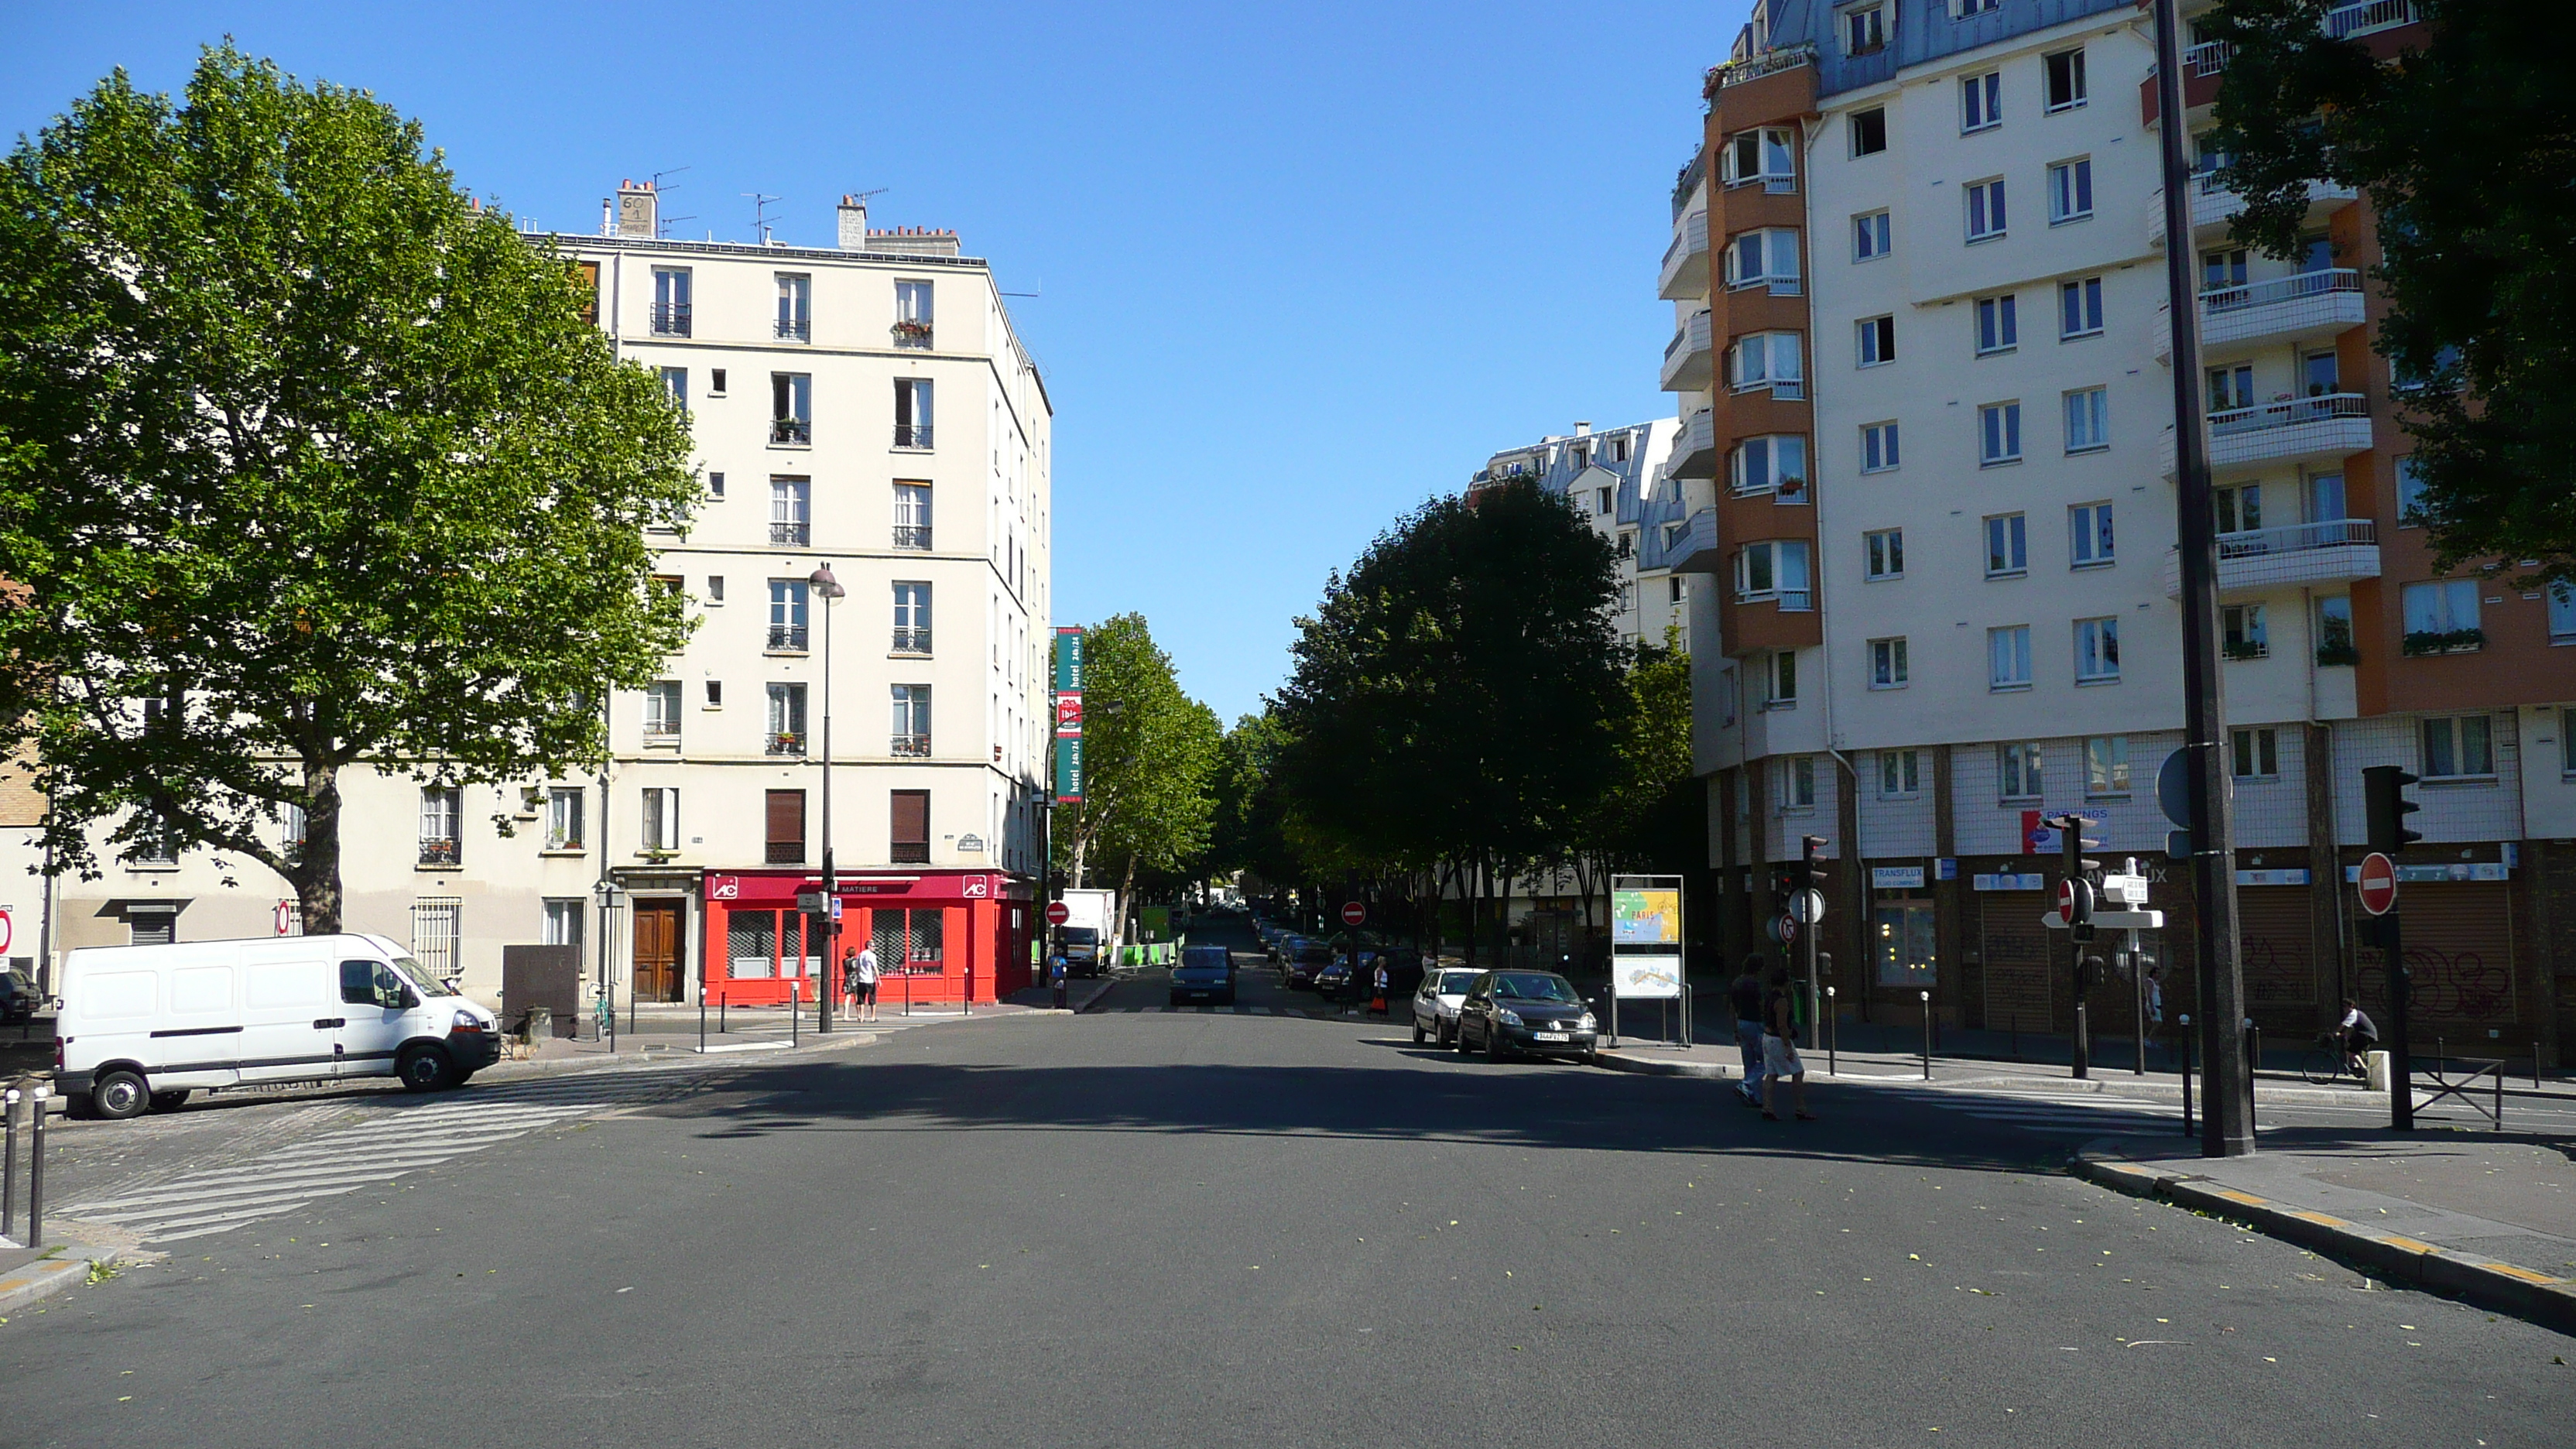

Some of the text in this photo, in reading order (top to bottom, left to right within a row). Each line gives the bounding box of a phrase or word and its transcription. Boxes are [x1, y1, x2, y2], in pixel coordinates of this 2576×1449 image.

[623, 197, 644, 208] 60
[1070, 665, 1080, 687] hotel
[1070, 769, 1080, 793] hotel
[1874, 868, 1922, 877] TRANSFLUX
[1632, 910, 1655, 920] PARIS
